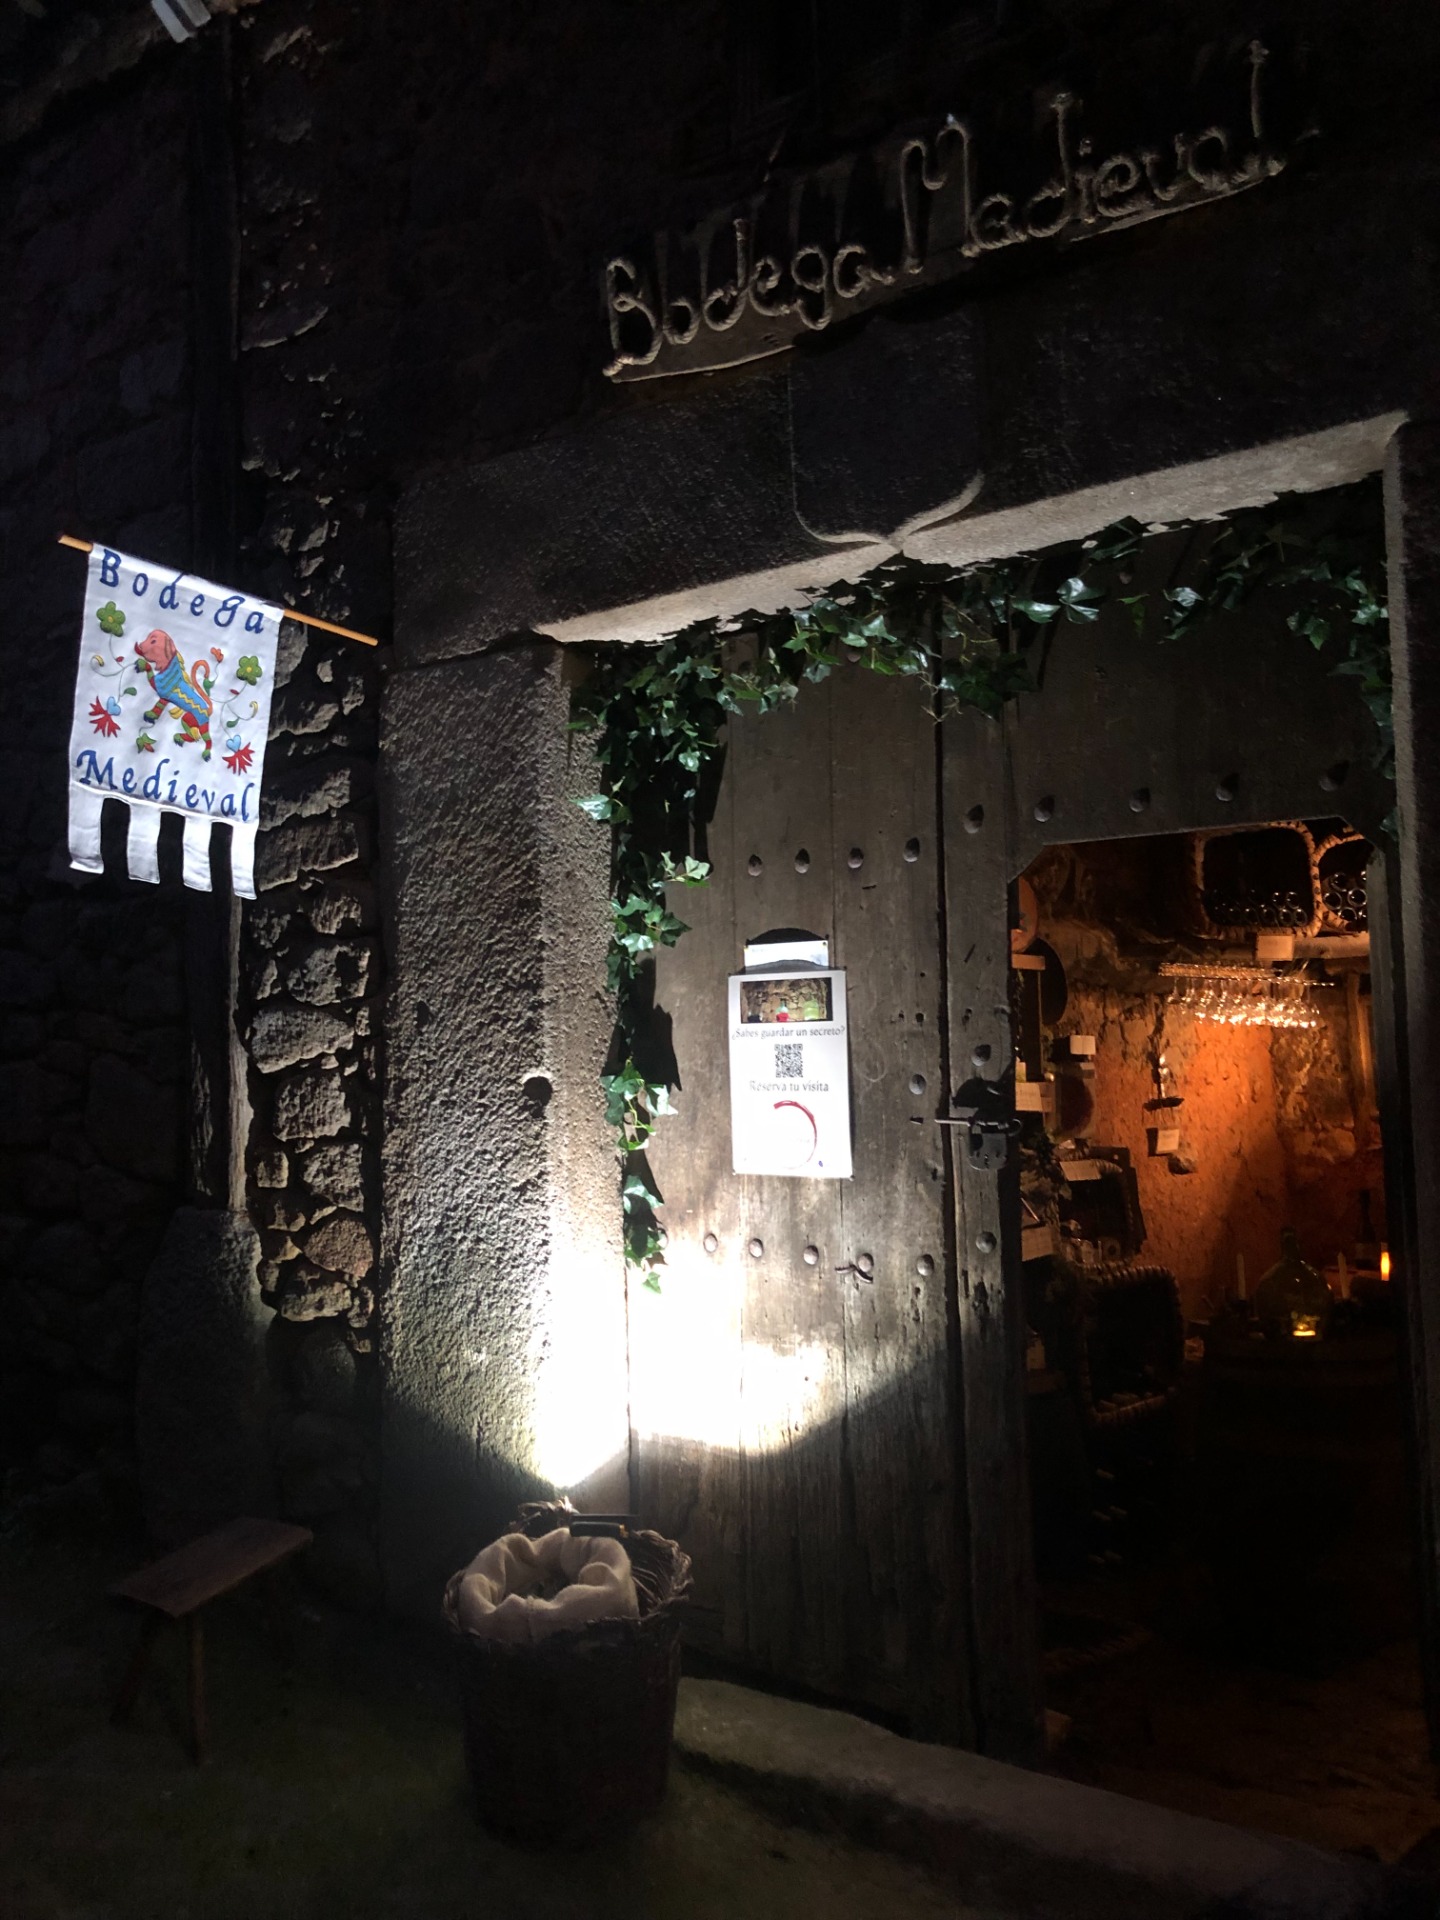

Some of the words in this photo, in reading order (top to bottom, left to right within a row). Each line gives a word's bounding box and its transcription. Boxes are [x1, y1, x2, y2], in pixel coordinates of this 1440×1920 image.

[602, 218, 896, 377] Bodega
[901, 40, 1288, 274] Medieval
[100, 548, 265, 634] Bodega
[76, 750, 255, 821] Medieval
[761, 1027, 793, 1039] guardar
[796, 1028, 808, 1037] un
[810, 1025, 845, 1037] secreto?
[749, 1081, 786, 1092] Reserva
[790, 1082, 799, 1092] tu
[802, 1080, 829, 1092] visita
